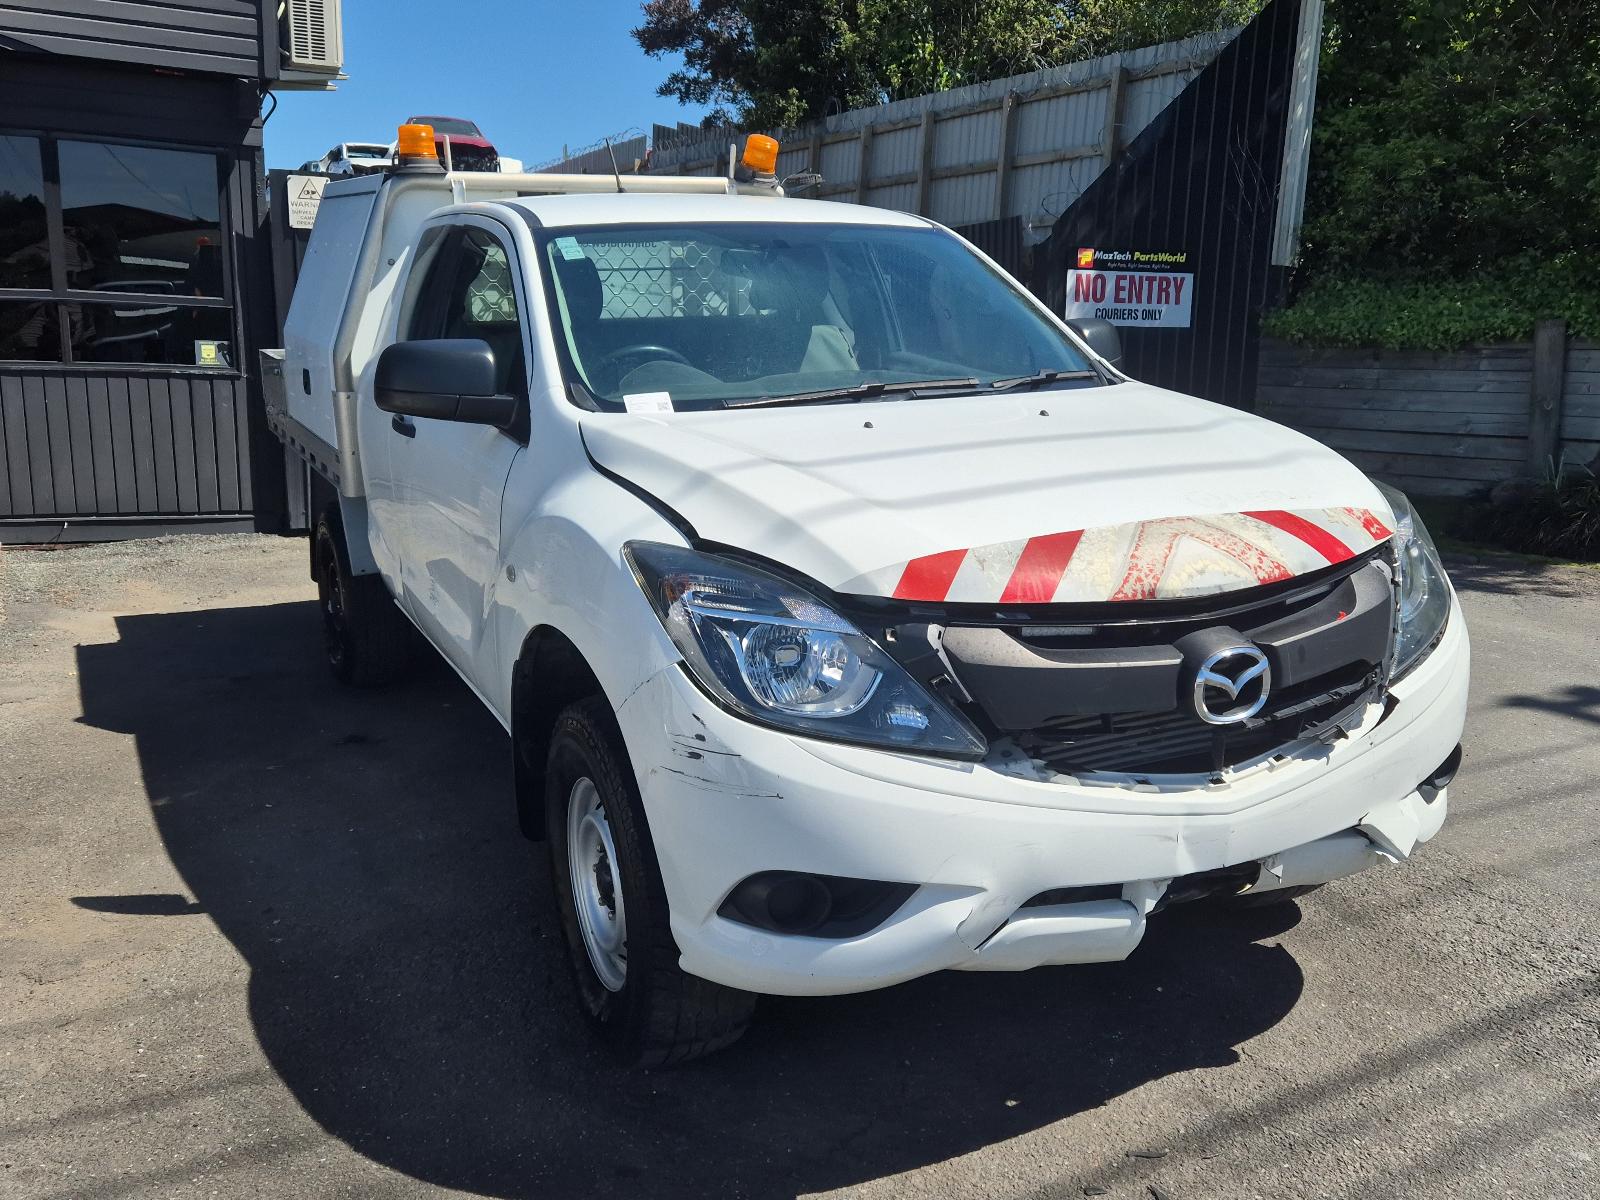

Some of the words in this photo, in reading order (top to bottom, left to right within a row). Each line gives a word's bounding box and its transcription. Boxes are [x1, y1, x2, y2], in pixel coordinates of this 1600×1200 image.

[1094, 250, 1132, 261] MazTech
[1133, 252, 1187, 263] PartsWorld
[1075, 273, 1107, 304] NO
[1114, 275, 1186, 305] ENTRY
[1095, 308, 1139, 320] COURIERS
[1142, 309, 1163, 321] ONLY
